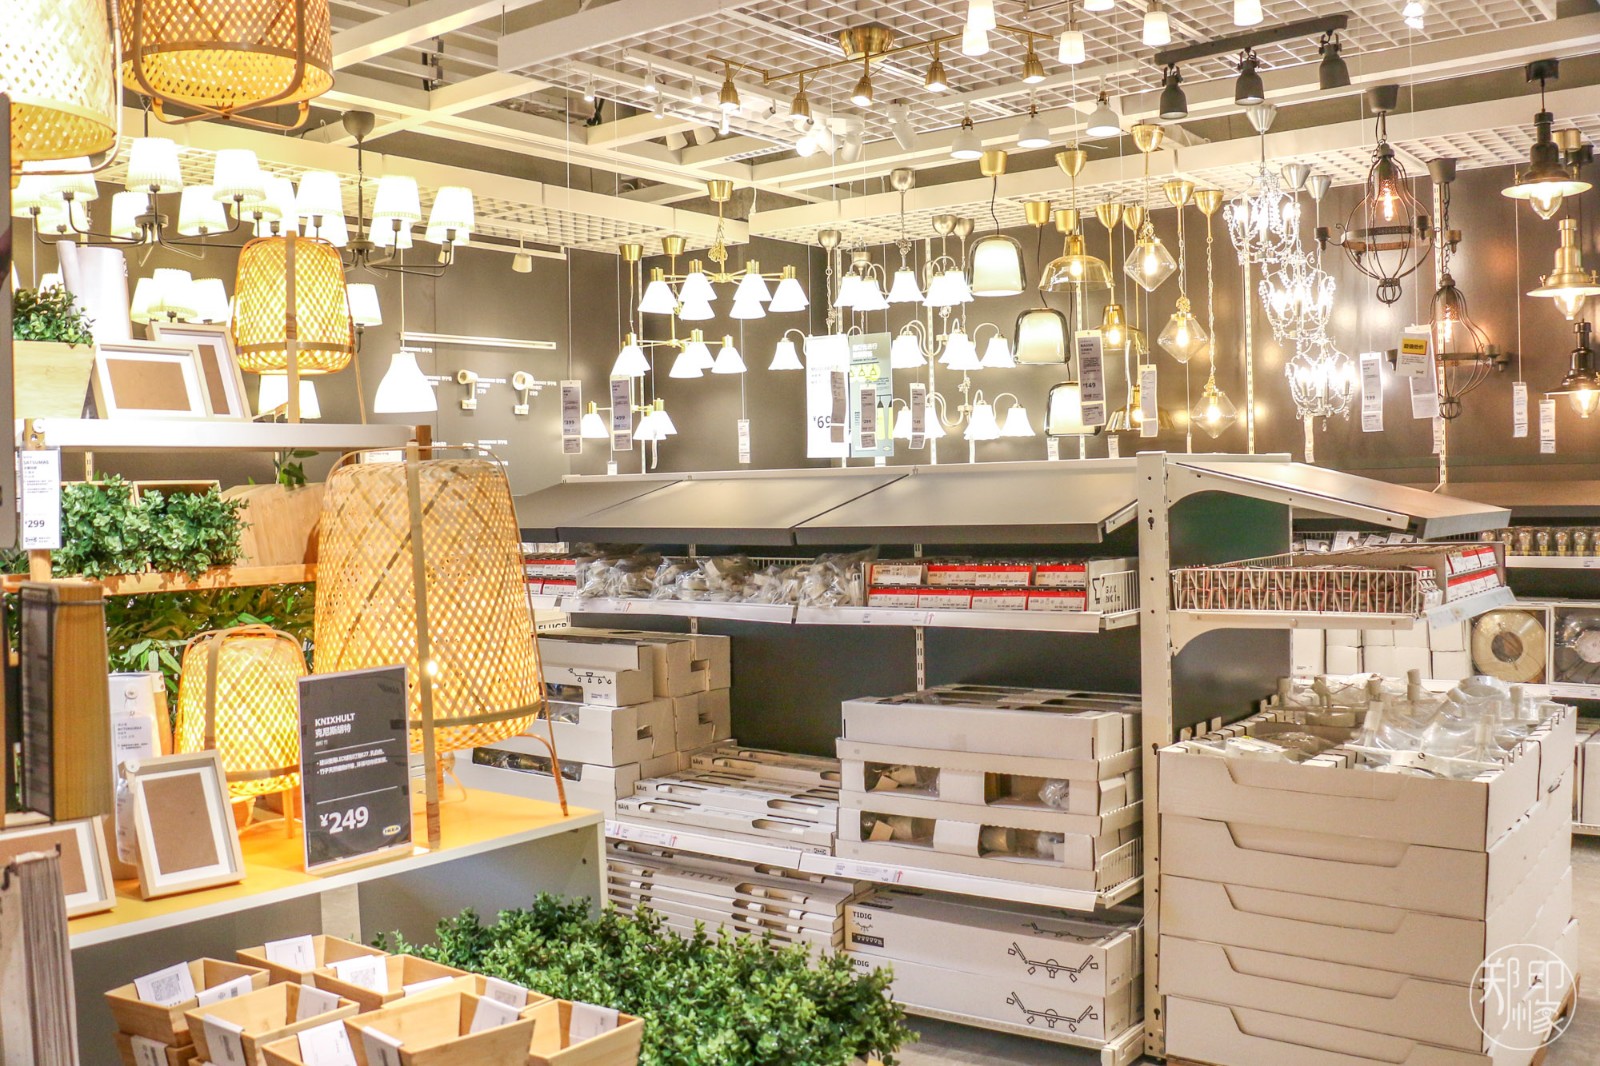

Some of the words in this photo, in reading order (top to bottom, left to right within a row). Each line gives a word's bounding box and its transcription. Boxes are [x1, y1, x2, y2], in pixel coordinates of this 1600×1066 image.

[315, 713, 356, 728] KNIXHULT
[319, 806, 369, 835] ¥249
[852, 911, 873, 921] TIDIG
[853, 960, 870, 968] IDIG
